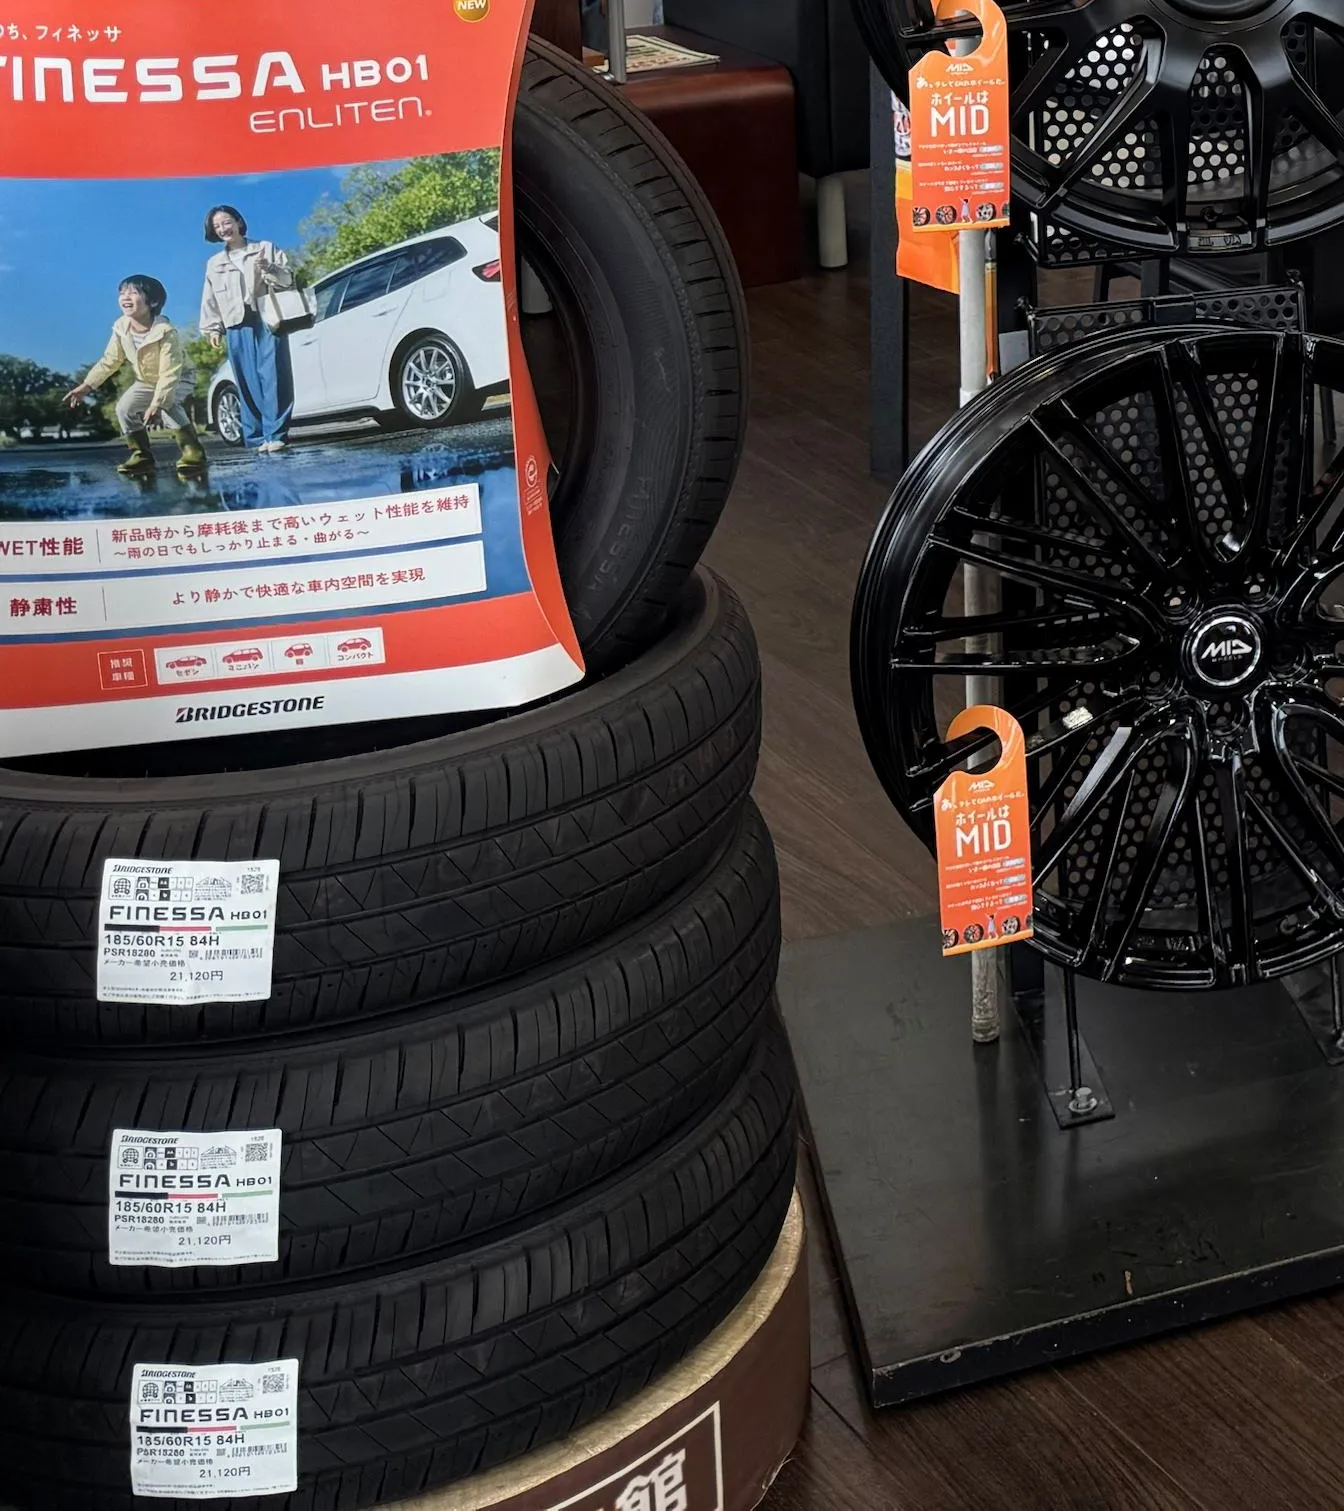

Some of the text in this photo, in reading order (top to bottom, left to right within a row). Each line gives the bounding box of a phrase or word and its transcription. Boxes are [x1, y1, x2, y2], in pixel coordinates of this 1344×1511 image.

[322, 54, 430, 91] HB01
[931, 91, 988, 106] ホイールは
[930, 105, 990, 137] MID
[111, 493, 470, 544] 新品時から摩耗後まで高いウェット性能を維持
[9, 567, 426, 617] 静粛性 より静かで快適な車内空間を実現
[1201, 639, 1252, 659] MID
[175, 696, 325, 724] BRIDGESTONE
[955, 805, 1010, 826] ホイールは
[955, 819, 1012, 858] MID
[110, 906, 267, 921] FINESSA HB01
[105, 934, 220, 946] 185/60R15 84H
[104, 948, 155, 957] PSR18280
[104, 959, 185, 967] メーカー希望小売価格
[170, 970, 223, 982] 21,120円
[120, 1174, 272, 1188] FINESSA HB01
[115, 1201, 226, 1213] 185/60R15 84H
[114, 1215, 165, 1223] PSR18280
[178, 1235, 231, 1246] 21,120円
[140, 1408, 289, 1422] FINESSA HB01
[137, 1434, 245, 1446] 185/60R15 84H
[200, 1466, 250, 1478] 21,120円
